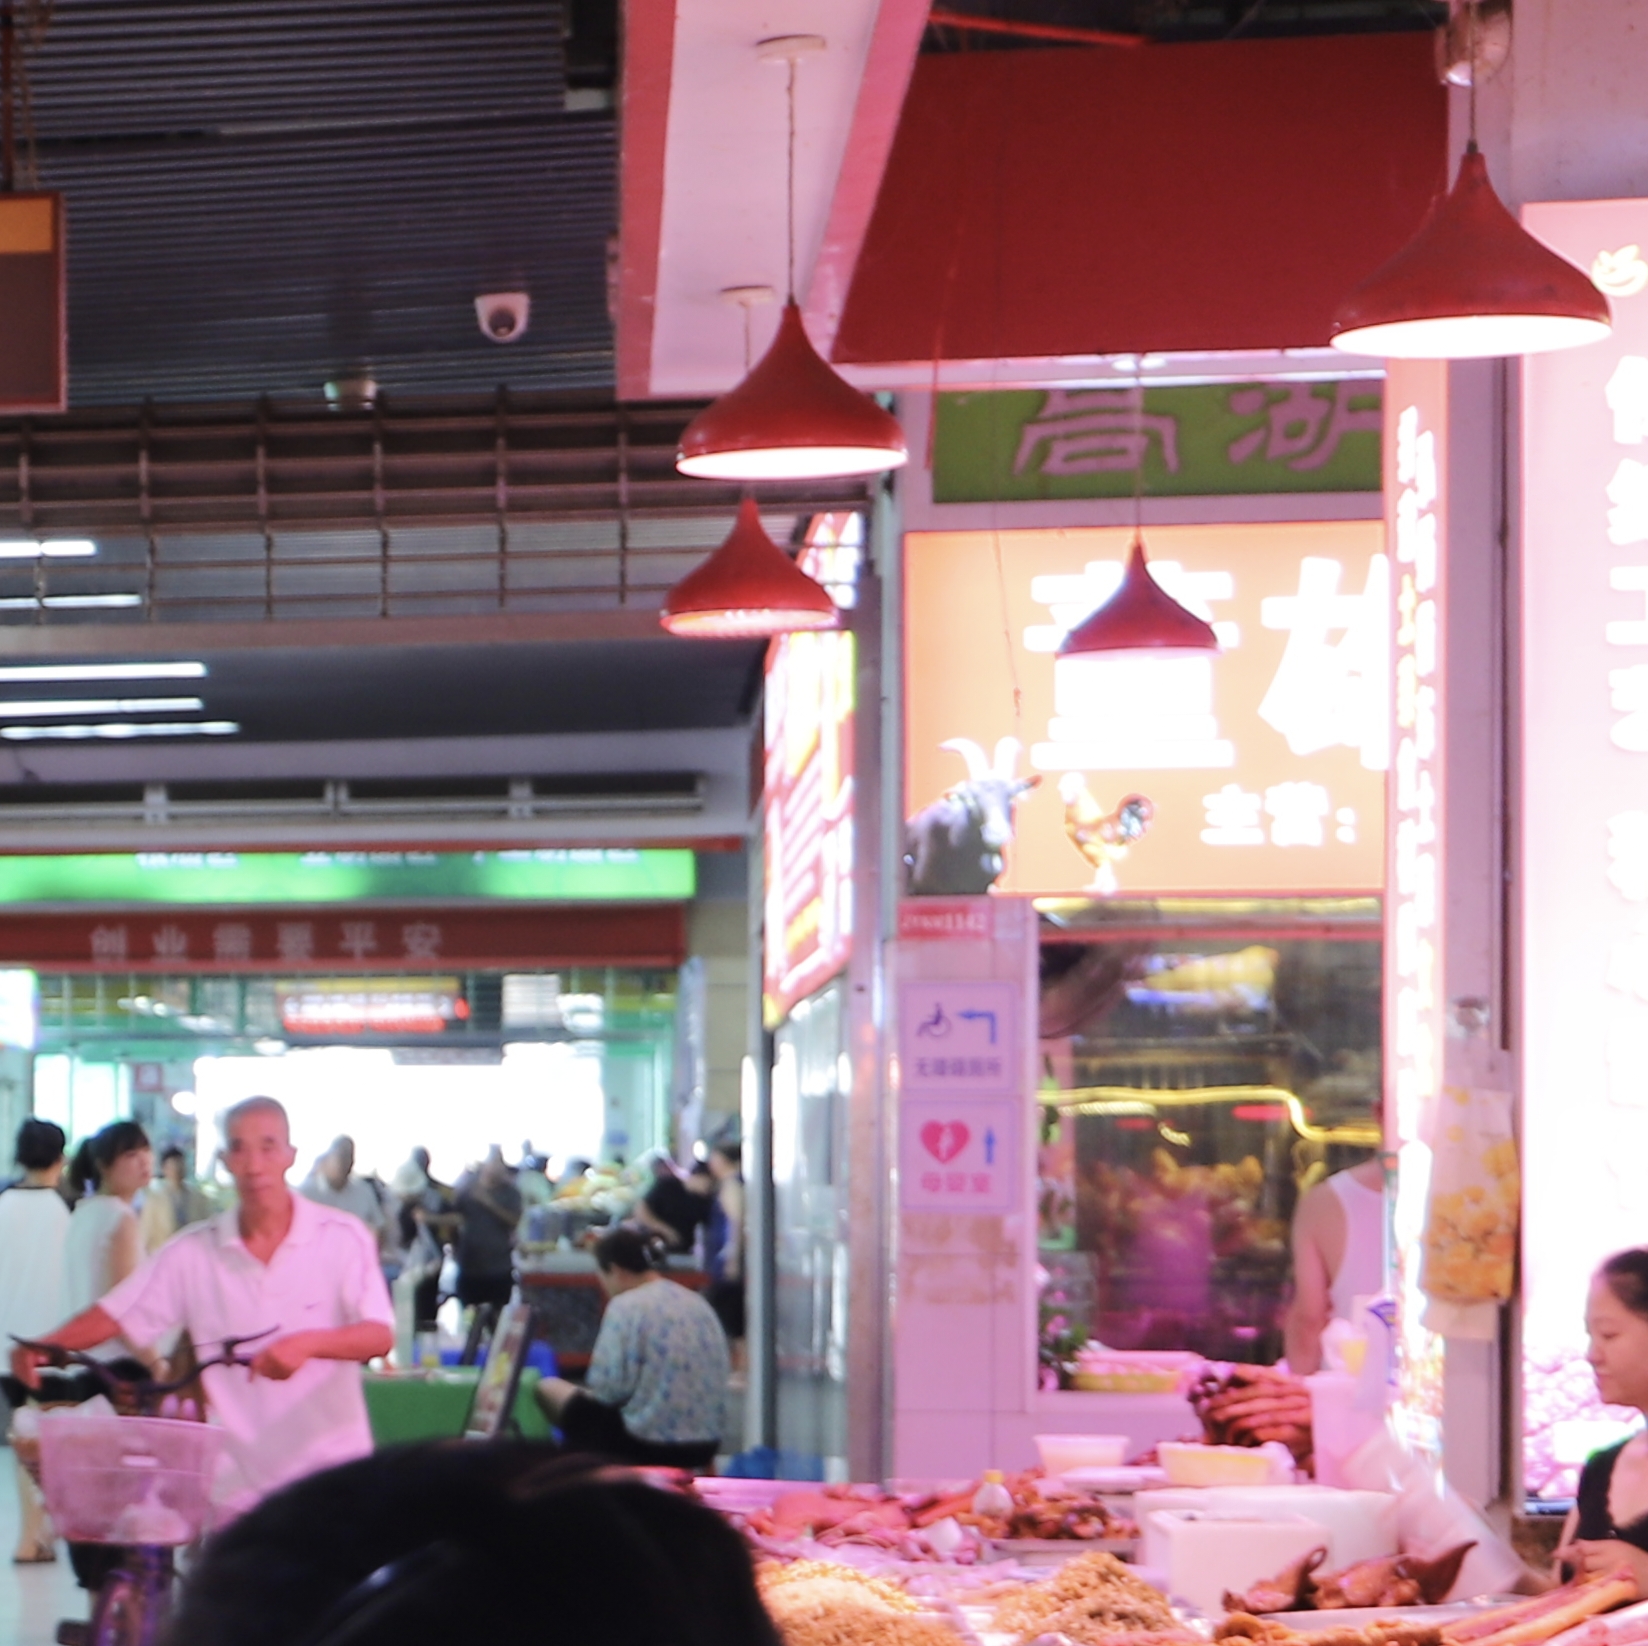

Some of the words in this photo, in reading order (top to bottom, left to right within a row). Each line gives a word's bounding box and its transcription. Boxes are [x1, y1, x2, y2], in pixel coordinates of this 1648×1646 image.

[90, 921, 444, 964] 创业需要平安
